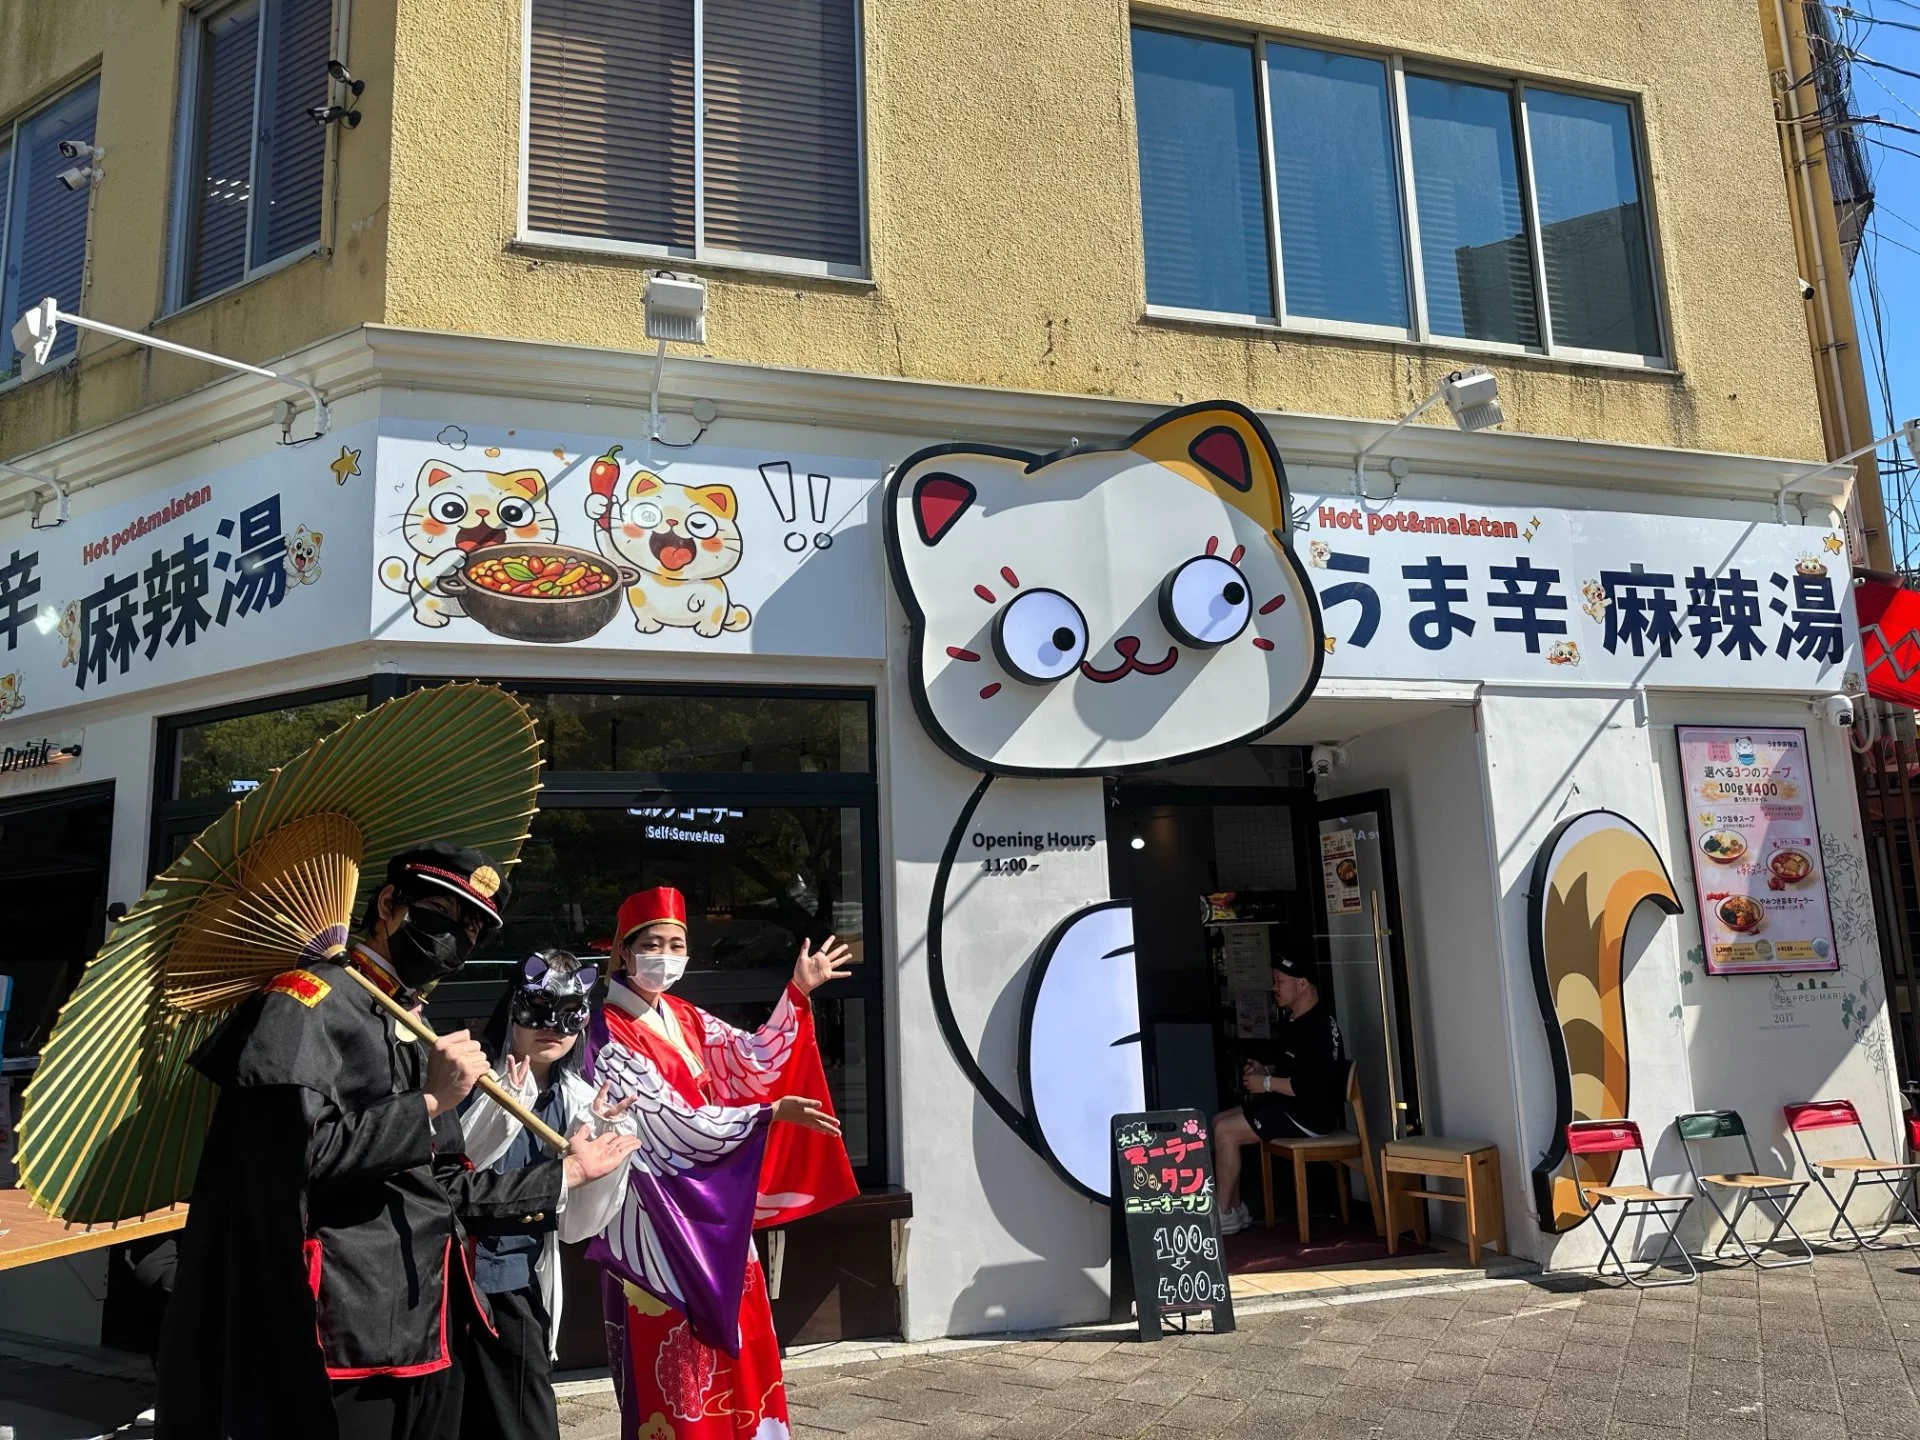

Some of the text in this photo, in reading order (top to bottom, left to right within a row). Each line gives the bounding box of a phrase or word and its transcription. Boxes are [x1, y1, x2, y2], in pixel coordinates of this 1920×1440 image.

[83, 485, 212, 566] Hot pot&malatan
[1318, 506, 1518, 538] Hot pot&malatan
[75, 493, 286, 691] 麻辣湯
[1601, 563, 1846, 665] 麻辣湯
[1719, 783, 1744, 796] 100g
[972, 831, 1096, 851] Opening Hours
[1118, 1129, 1152, 1147] 大人気
[1124, 1137, 1204, 1165] マーラー
[1162, 1168, 1204, 1194] タン
[1153, 1225, 1218, 1260] 100g
